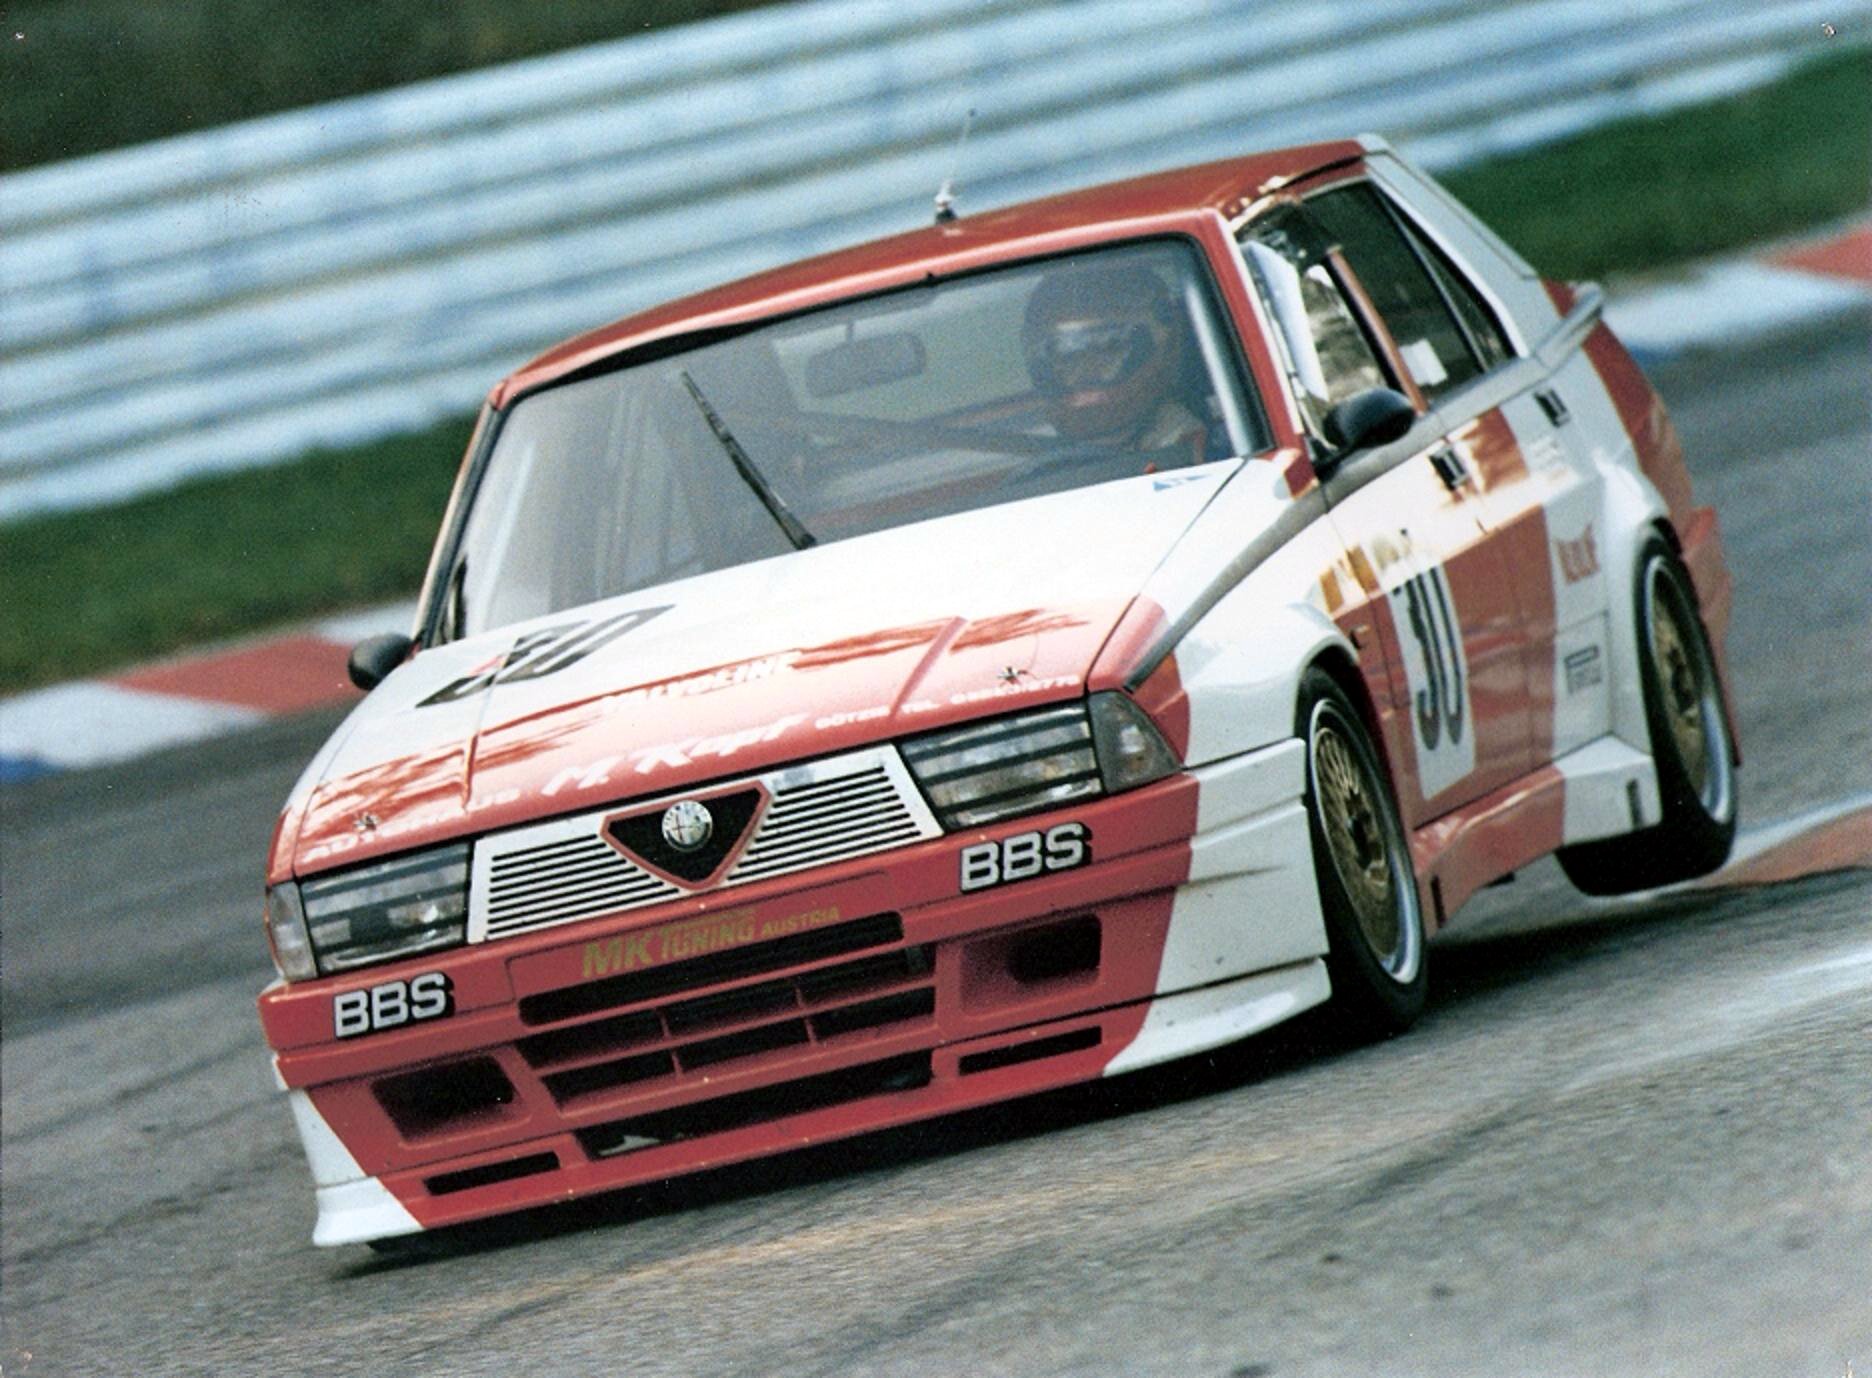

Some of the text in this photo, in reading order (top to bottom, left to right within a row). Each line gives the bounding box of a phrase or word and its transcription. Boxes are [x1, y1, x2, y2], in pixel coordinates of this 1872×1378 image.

[964, 822, 1086, 892] BBS
[583, 929, 652, 978] MK
[659, 908, 757, 960] TUNING
[334, 972, 448, 1038] BBS
